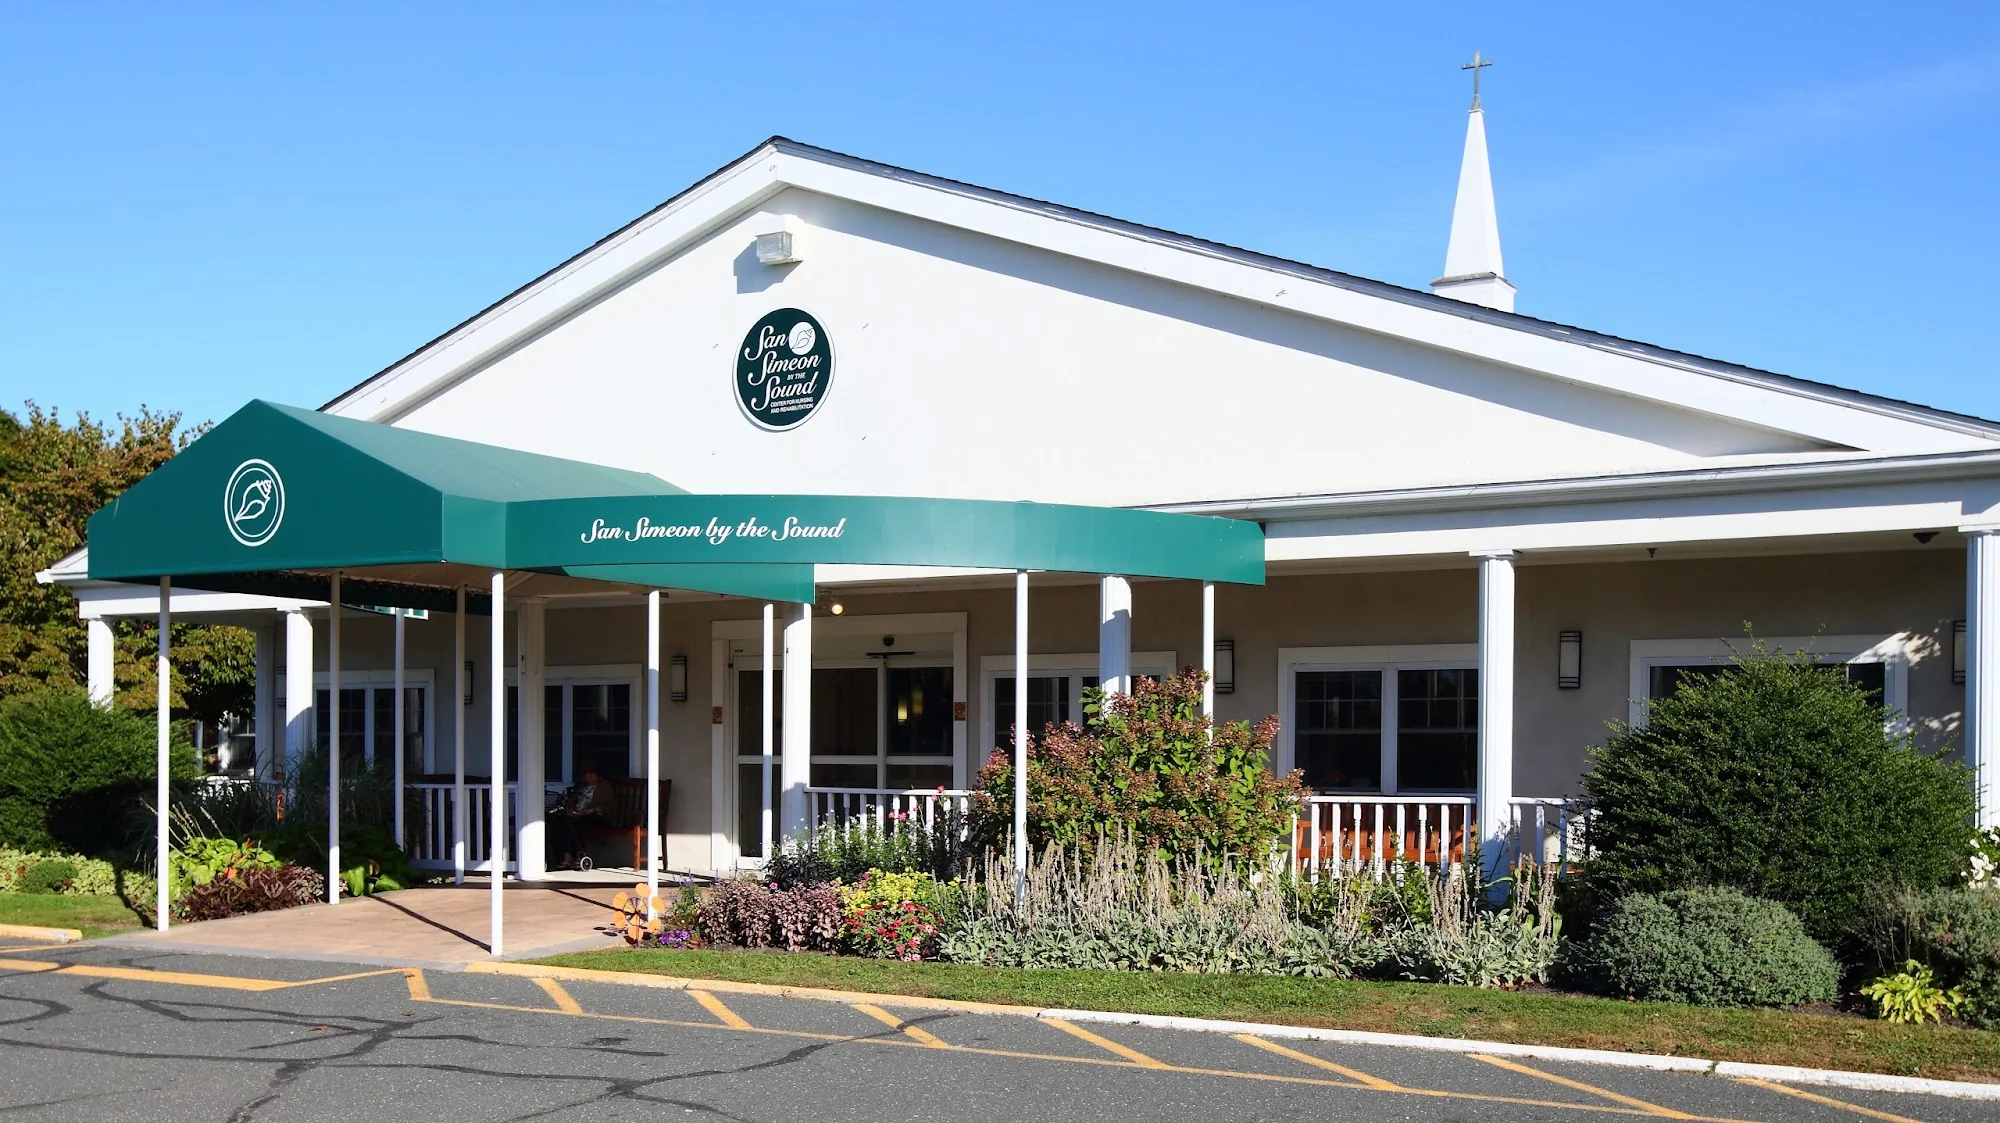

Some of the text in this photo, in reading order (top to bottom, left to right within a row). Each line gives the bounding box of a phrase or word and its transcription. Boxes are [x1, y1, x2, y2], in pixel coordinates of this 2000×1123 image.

[744, 325, 789, 361] San
[747, 350, 823, 386] Simeon
[787, 372, 806, 381] BY THE
[751, 371, 819, 411] Sound
[770, 400, 787, 408] CENTER
[580, 516, 847, 545] San Simeon by the Sound
